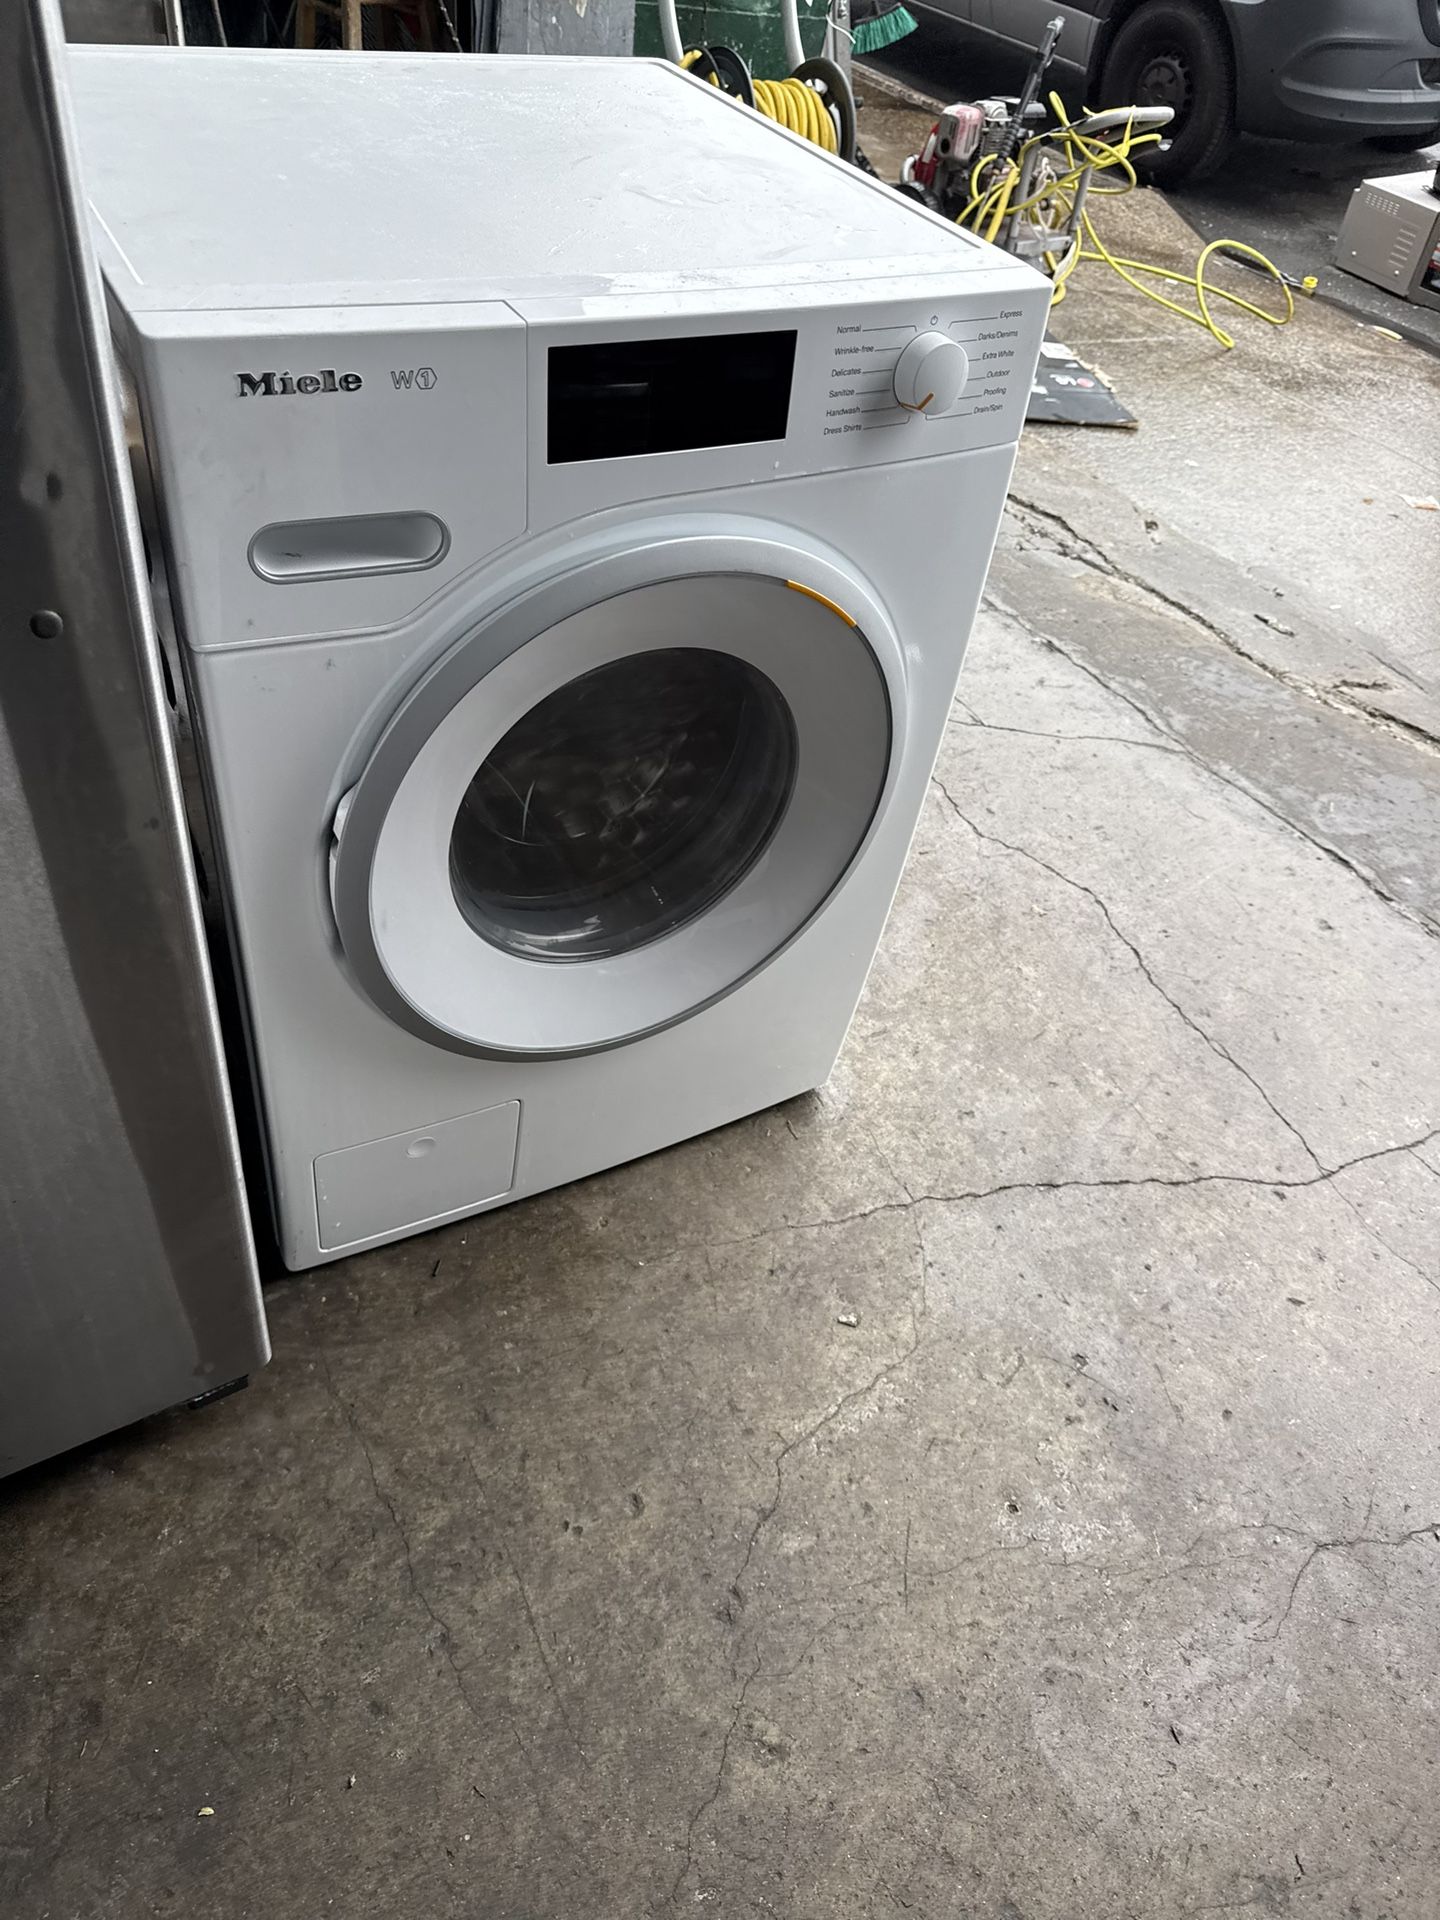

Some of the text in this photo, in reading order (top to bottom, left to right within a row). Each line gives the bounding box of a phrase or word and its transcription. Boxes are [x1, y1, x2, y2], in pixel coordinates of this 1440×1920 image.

[999, 310, 1023, 319] Express
[836, 324, 862, 334] Normal
[978, 330, 1018, 341] Darks/Denims
[834, 345, 875, 356] Wrinkle-free
[982, 350, 1015, 360] Extra White
[831, 367, 862, 377] Delicates
[986, 370, 1011, 378] Outdoor
[235, 369, 364, 398] Miele
[828, 388, 855, 398] Sanitize
[983, 387, 1007, 396] Proofing
[826, 406, 861, 417] Handwash
[823, 423, 863, 436] Dress Shirts
